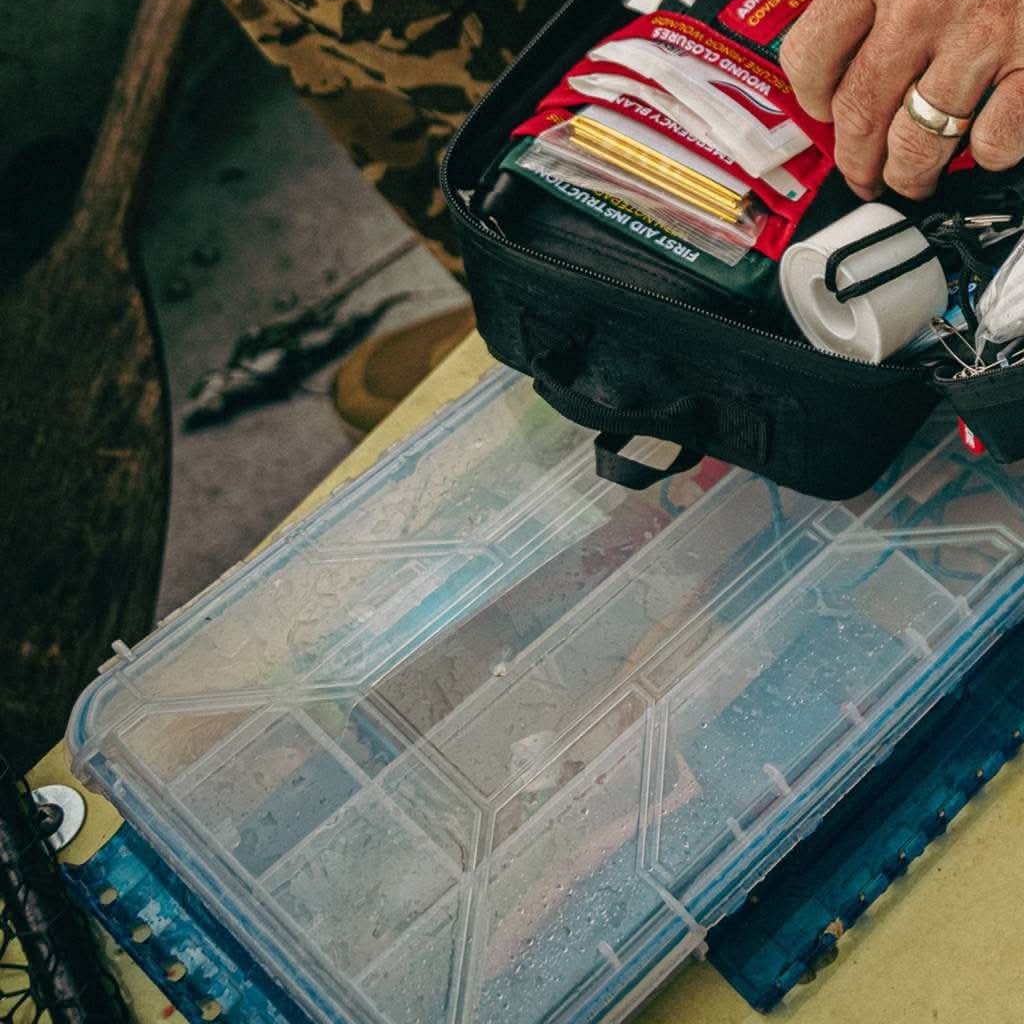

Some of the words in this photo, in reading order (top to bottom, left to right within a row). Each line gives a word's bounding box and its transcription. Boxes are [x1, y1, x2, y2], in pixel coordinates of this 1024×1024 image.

[651, 25, 720, 63] CLOSURES
[716, 56, 769, 95] WOUND
[744, 60, 790, 93] SECURE
[612, 94, 651, 116] BLAN
[648, 112, 735, 164] EMERGENCY
[628, 218, 659, 236] AID
[653, 233, 700, 263] FIRST
